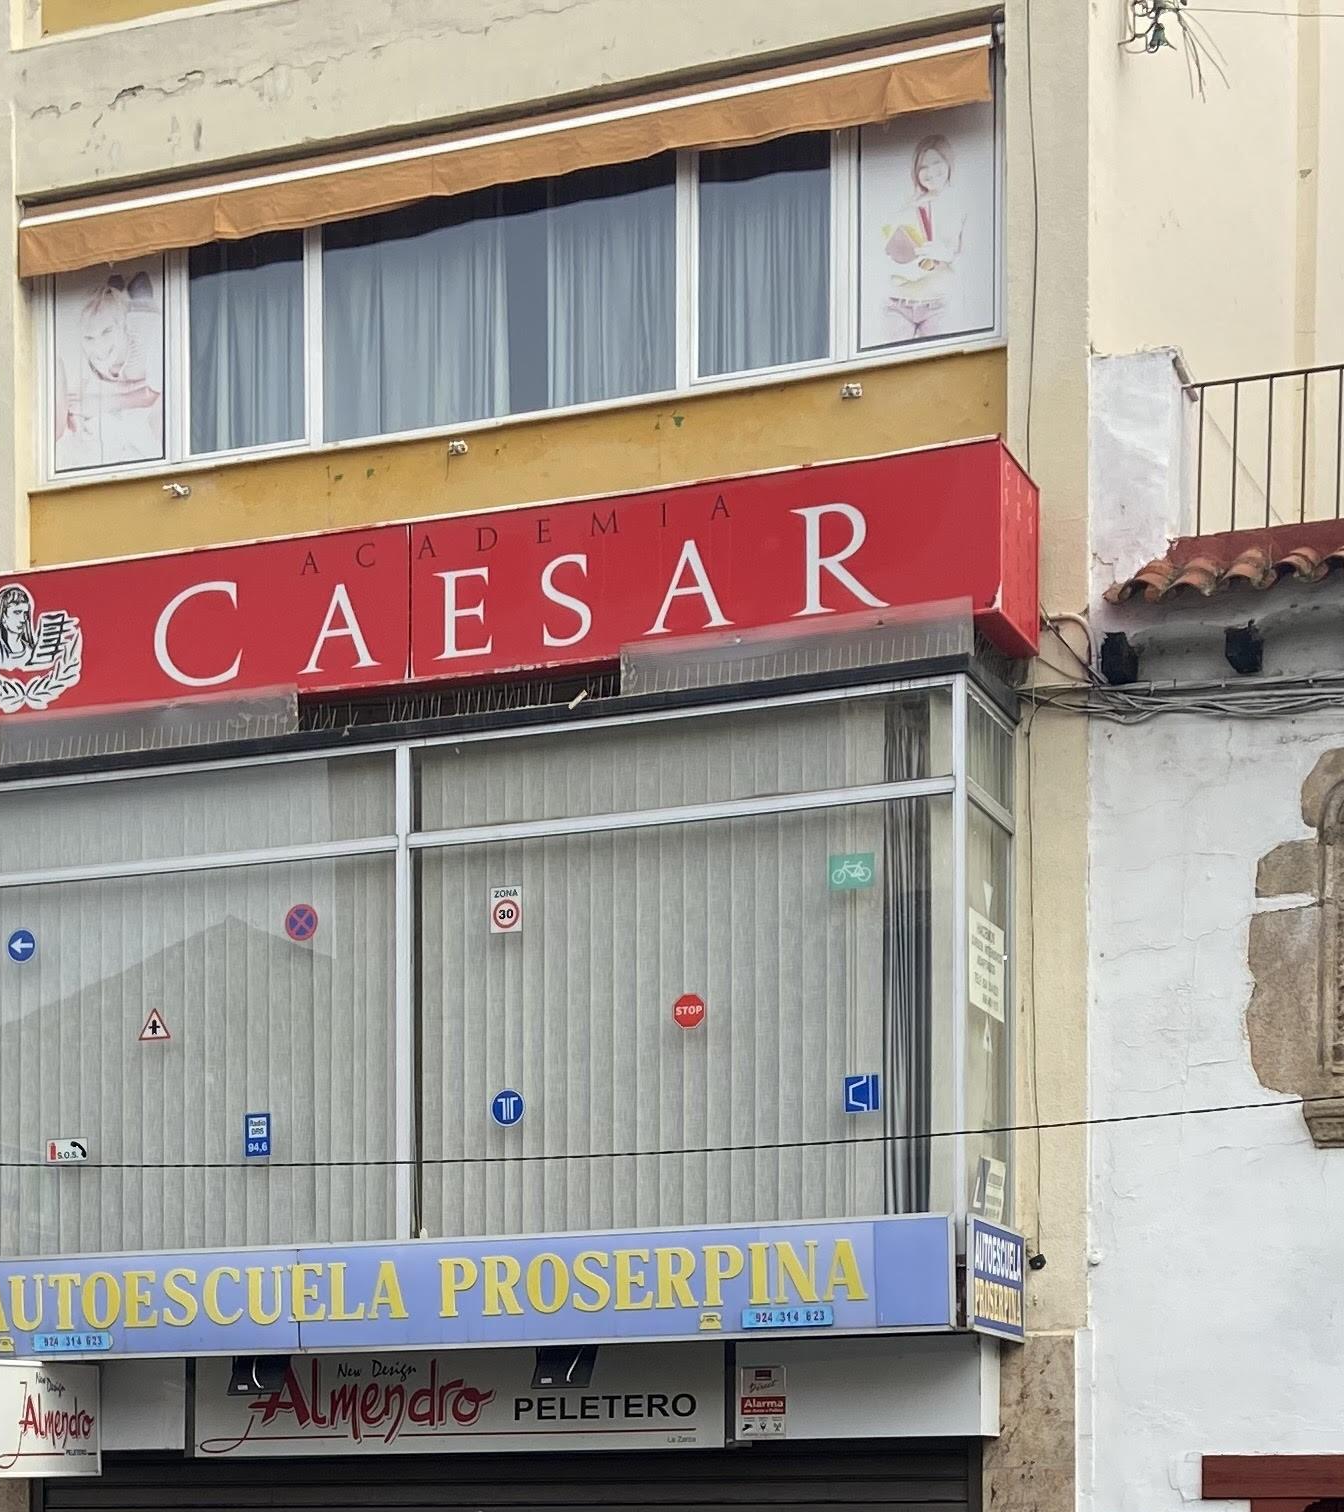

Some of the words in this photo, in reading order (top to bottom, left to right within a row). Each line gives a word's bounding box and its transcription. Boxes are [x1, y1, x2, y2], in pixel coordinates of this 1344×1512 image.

[302, 494, 731, 575] ACADEMIA
[154, 503, 888, 687] CAESAR
[494, 889, 518, 898] ZONA
[498, 909, 514, 920] 30
[676, 1005, 703, 1016] STOP
[975, 1230, 1022, 1283] AUTOESCUELA
[438, 1238, 868, 1318] PROSERPINA
[756, 1312, 773, 1323] 924
[337, 1362, 362, 1378] New
[370, 1360, 418, 1380] Design
[513, 1393, 698, 1422] PELETERO
[744, 1399, 784, 1408] Alarma
